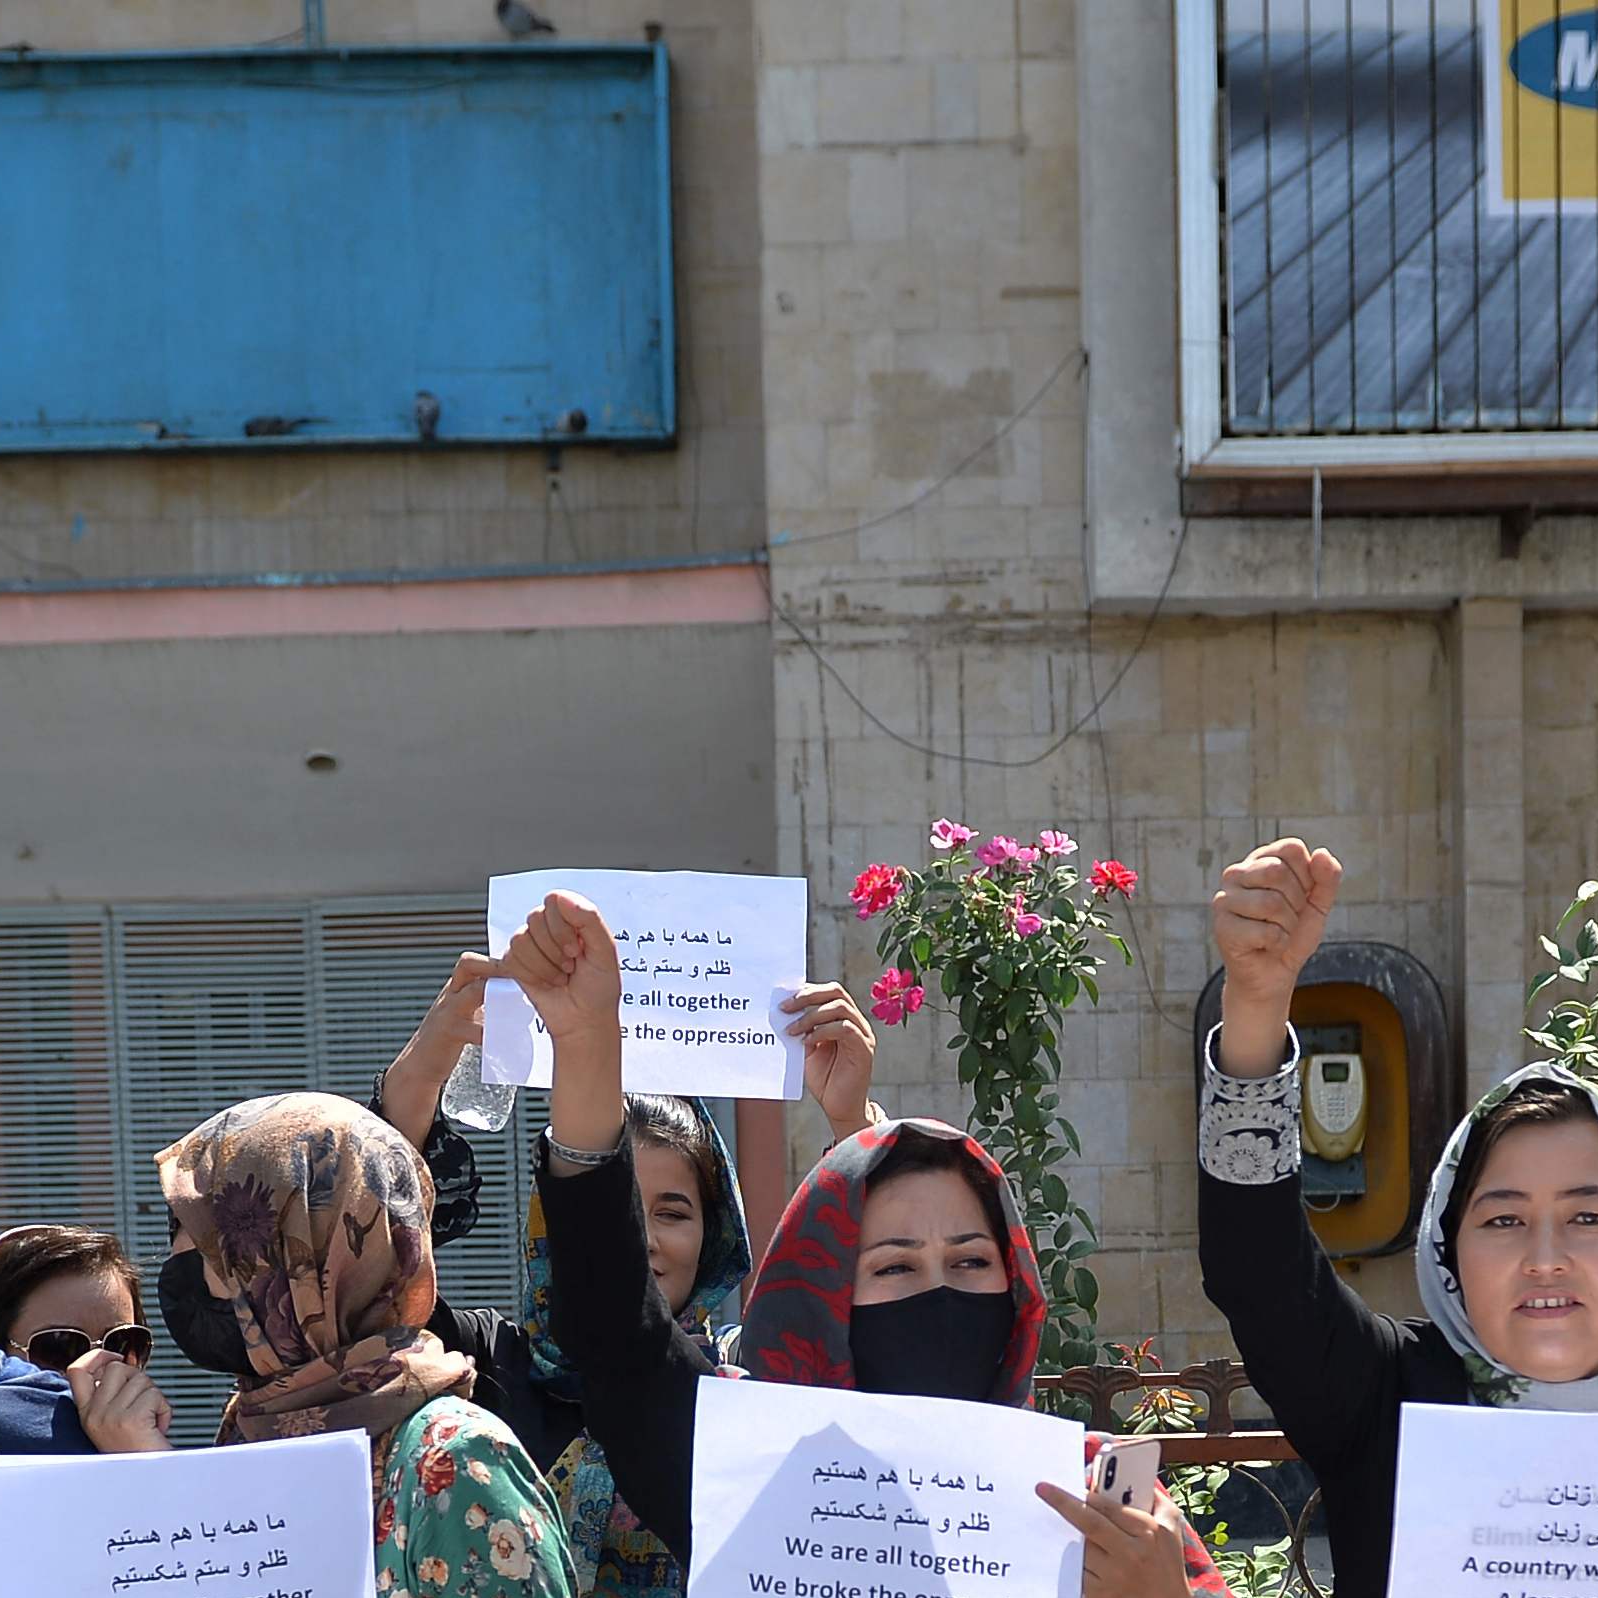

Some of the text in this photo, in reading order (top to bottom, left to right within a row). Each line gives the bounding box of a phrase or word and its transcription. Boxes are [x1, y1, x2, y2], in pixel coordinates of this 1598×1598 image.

[636, 930, 656, 951] هم
[662, 928, 675, 947] با
[680, 930, 710, 945] همه
[716, 930, 732, 945] ما
[652, 958, 683, 981] ستم
[687, 965, 699, 979] و
[704, 959, 731, 983] ظلم
[639, 989, 662, 1007] all
[666, 992, 751, 1013] together
[634, 1022, 667, 1041] the
[671, 1027, 775, 1047] oppression
[812, 1460, 995, 1493] ما همه با هم هستیم
[1546, 1484, 1592, 1508] زنان
[810, 1499, 991, 1538] ظلم و ستم شکستیم
[106, 1513, 286, 1556] ما همه با هم هستیم
[1536, 1521, 1581, 1544] زبان
[784, 1536, 1011, 1578] We are all together
[1461, 1556, 1479, 1573] A
[1486, 1559, 1576, 1581] country
[111, 1548, 289, 1594] ظلم و ستم شکستیم
[748, 1572, 788, 1596] We
